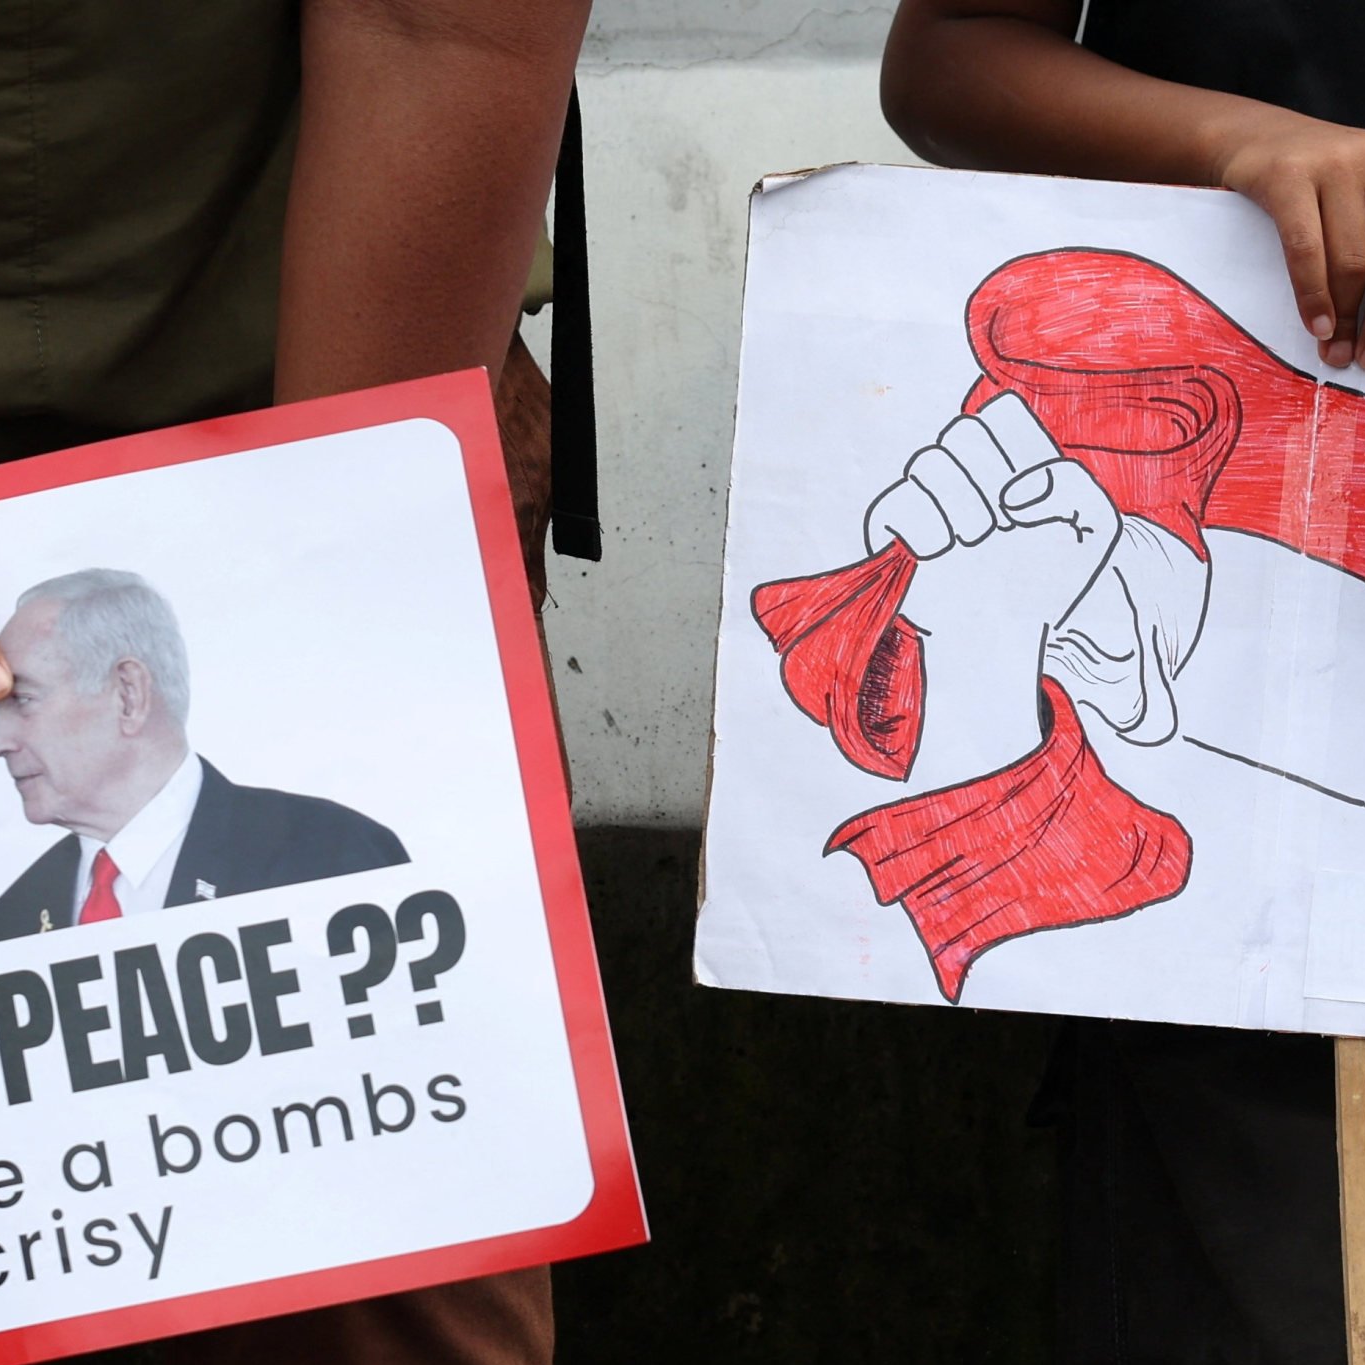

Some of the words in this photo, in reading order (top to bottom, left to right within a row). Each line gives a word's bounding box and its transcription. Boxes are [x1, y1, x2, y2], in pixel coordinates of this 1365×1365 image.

[327, 890, 467, 1040] ??
[62, 1141, 112, 1192] a
[149, 1074, 467, 1176] bombs
